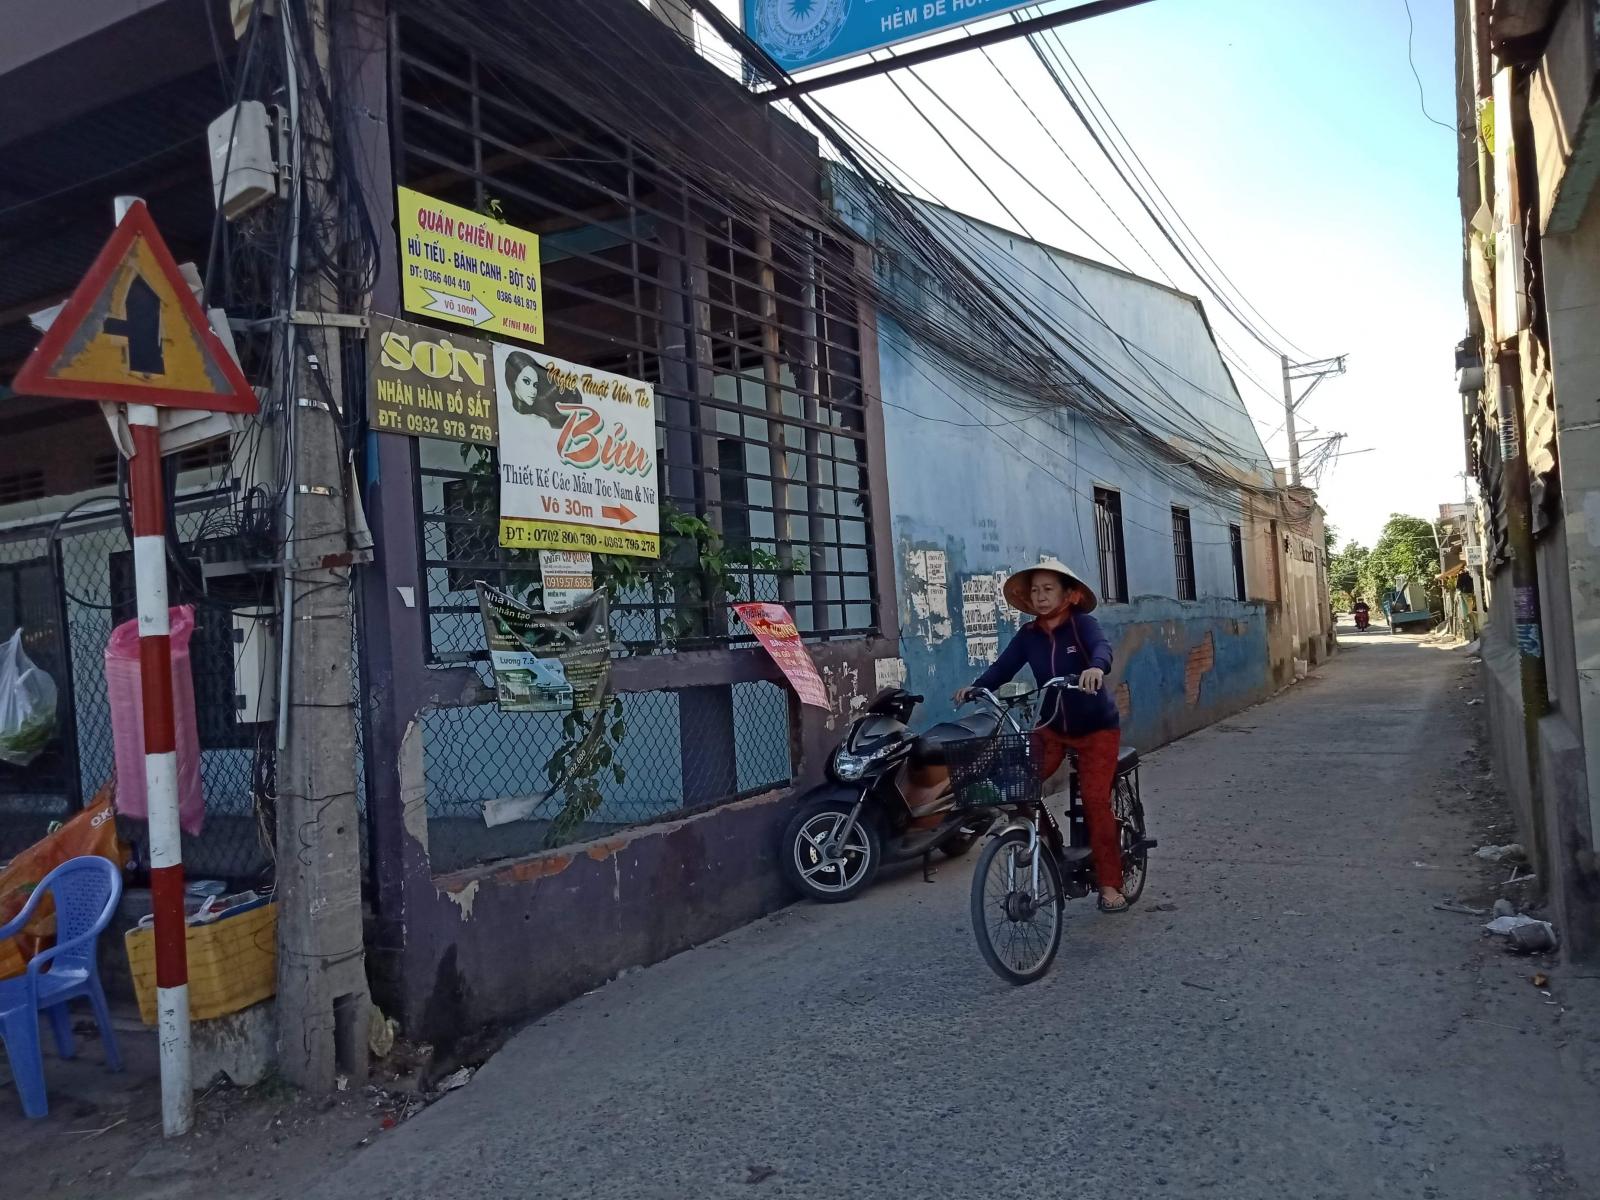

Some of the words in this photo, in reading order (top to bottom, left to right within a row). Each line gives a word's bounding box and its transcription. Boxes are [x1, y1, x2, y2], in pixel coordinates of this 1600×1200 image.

[880, 6, 918, 32] HẺM
[417, 207, 454, 237] QUÁN
[457, 222, 494, 251] CHIẾN
[497, 235, 527, 261] LOAN
[407, 233, 421, 257] HỦ
[423, 240, 445, 265] TIẾU
[453, 249, 478, 274] BÁNH
[480, 260, 502, 282] CANH
[508, 267, 524, 291] BỘT
[409, 264, 423, 278] ĐT:
[423, 268, 442, 284] 0366
[443, 275, 457, 289] 404
[457, 279, 471, 293] 410
[457, 302, 478, 316] 100M
[380, 331, 487, 386] SƠN
[377, 379, 414, 410] NHẬN
[417, 383, 444, 411] HÀN
[446, 388, 464, 414] ĐỒ
[467, 390, 492, 418] SẮT
[545, 361, 579, 395] Nghệ
[580, 373, 610, 401] Thuật
[378, 409, 402, 429] ĐT:
[406, 413, 439, 434] 0932
[443, 419, 467, 438] 978
[470, 423, 493, 441] 279
[502, 463, 534, 486] Thiết
[535, 467, 550, 489] Kế
[552, 470, 571, 492] Các
[572, 472, 593, 495] Mẫu
[595, 477, 612, 498] Tóc
[613, 481, 634, 501] Nam
[634, 484, 643, 503] &
[643, 486, 656, 505] Nữ
[540, 495, 560, 513] Vô
[564, 499, 594, 518] 30m
[533, 528, 560, 543] 0702
[561, 531, 579, 545] 800
[579, 533, 598, 546] 730
[604, 535, 624, 549] 0362
[624, 538, 640, 551] 795
[640, 540, 656, 553] 278
